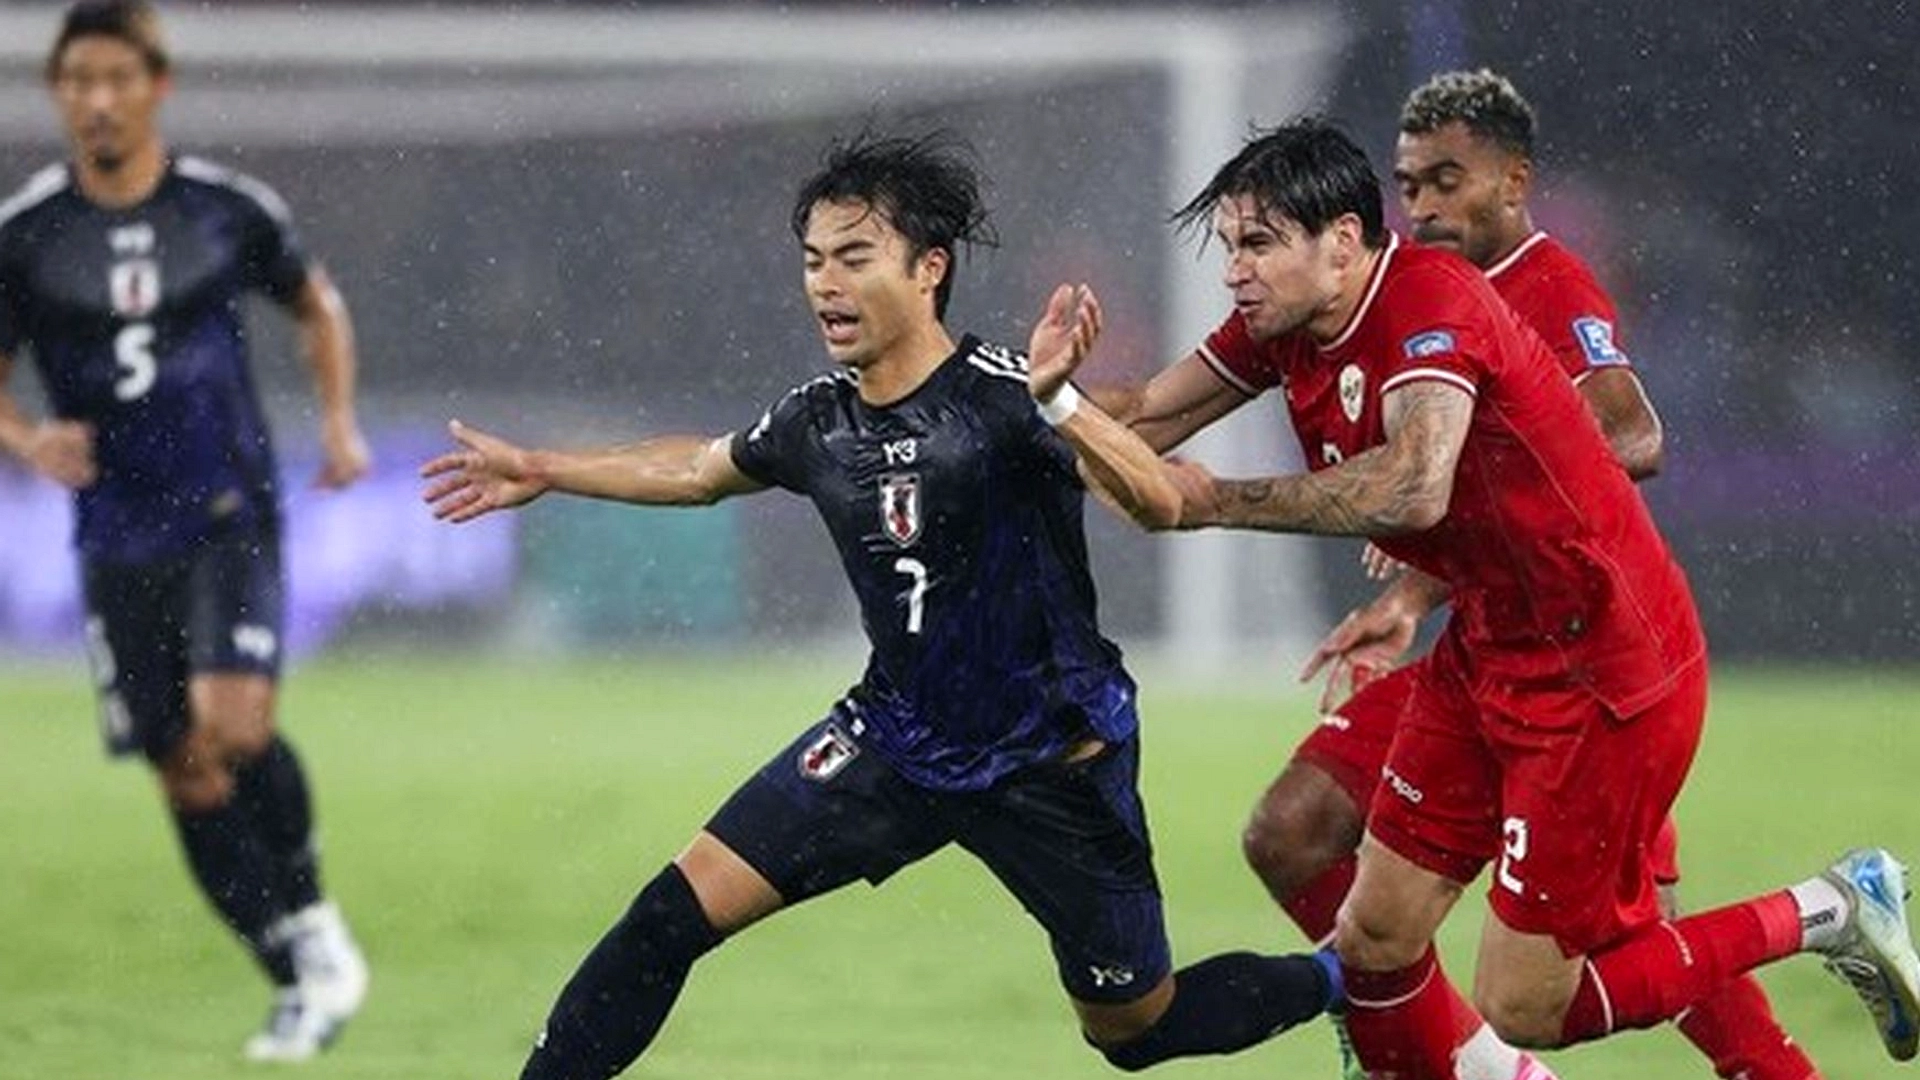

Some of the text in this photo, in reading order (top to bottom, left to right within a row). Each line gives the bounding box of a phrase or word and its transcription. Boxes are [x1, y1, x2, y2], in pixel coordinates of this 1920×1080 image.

[114, 323, 157, 400] 5
[895, 557, 927, 633] 7
[1500, 817, 1527, 895] 2
